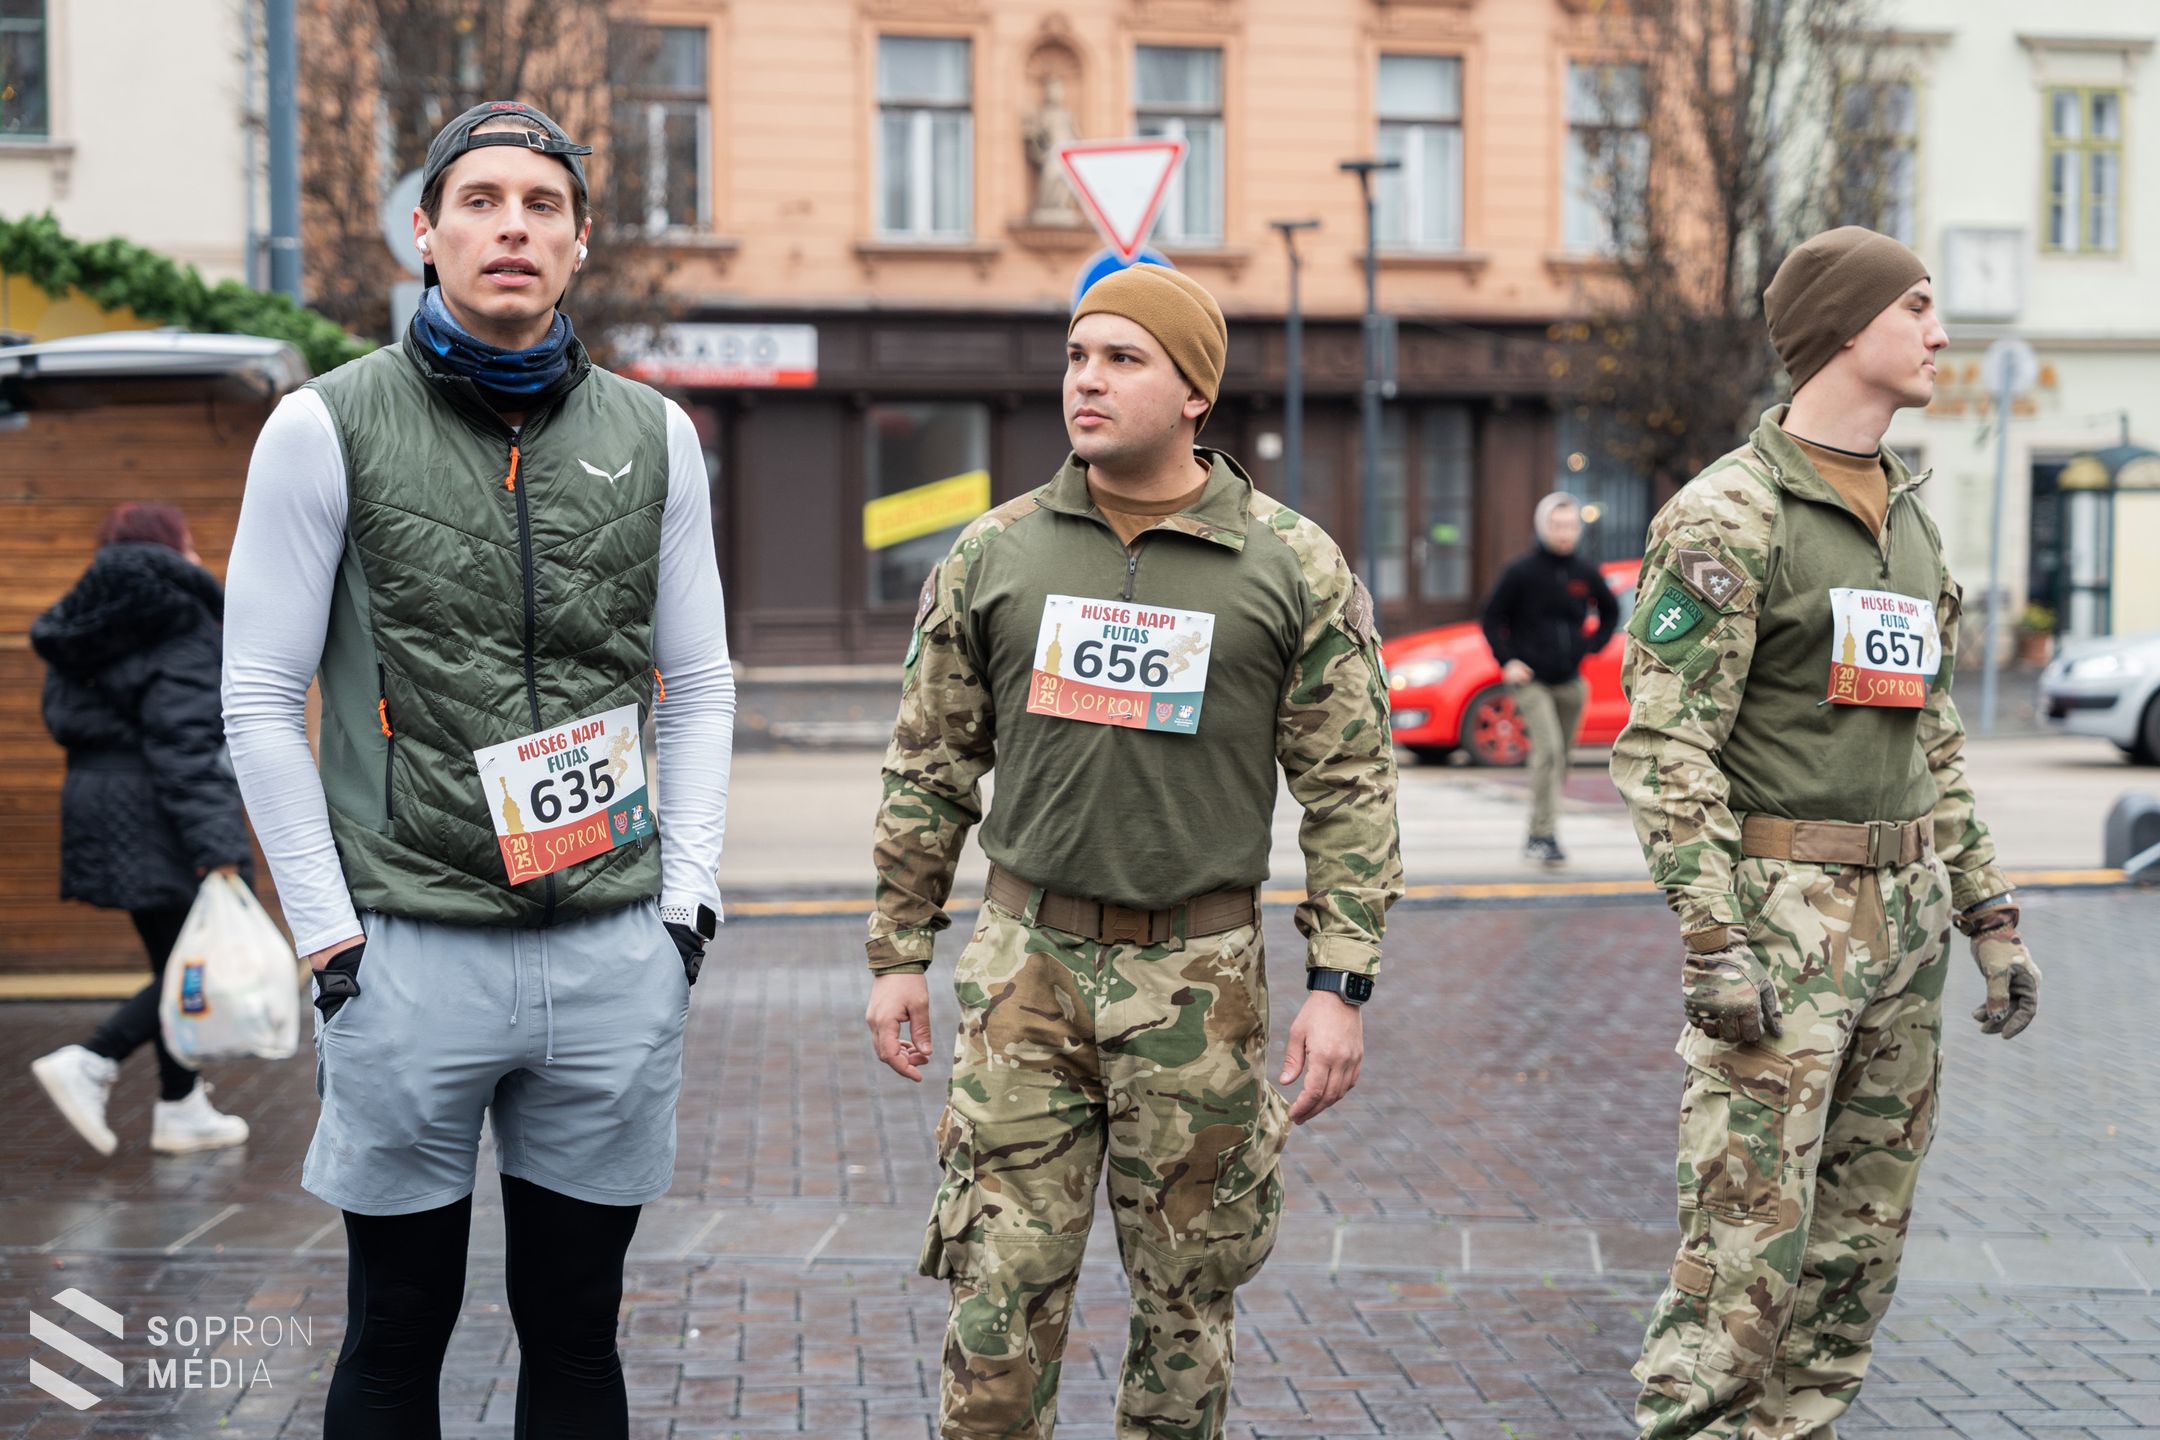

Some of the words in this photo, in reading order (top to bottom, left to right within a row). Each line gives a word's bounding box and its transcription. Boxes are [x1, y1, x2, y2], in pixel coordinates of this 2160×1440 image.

[1898, 600, 1919, 617] NAPI
[1136, 611, 1177, 630] NAPI
[1102, 622, 1150, 645] FUTÁS
[1865, 629, 1924, 669] 657
[1073, 639, 1170, 688] 656
[1839, 667, 1855, 680] 20
[1040, 676, 1058, 690] 20
[1837, 681, 1853, 694] 25
[1868, 678, 1923, 703] SOPRON
[1038, 691, 1055, 705] 25
[1071, 691, 1144, 718] SOPRON
[517, 733, 568, 762] HŰSÉG
[571, 719, 606, 746] NAPI
[547, 743, 590, 774] FUTÁS
[530, 758, 615, 824] 635
[509, 836, 529, 853] 20
[545, 820, 608, 873] SOPRON
[514, 853, 533, 870] 25
